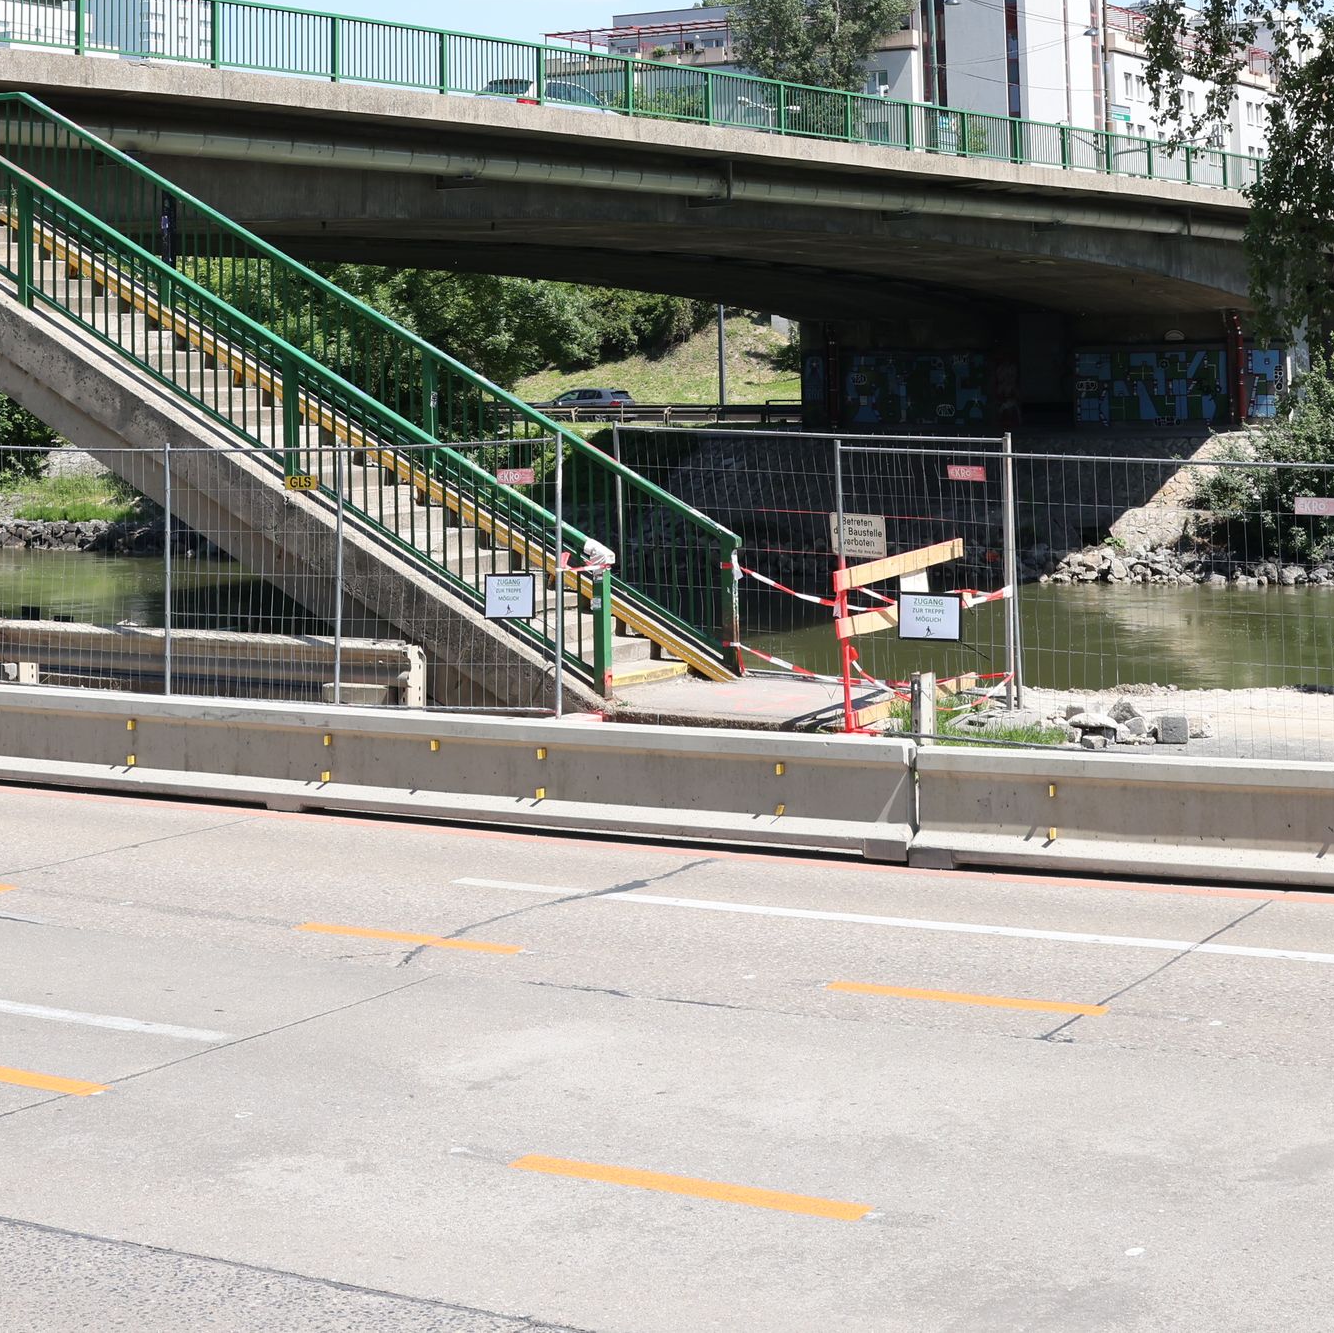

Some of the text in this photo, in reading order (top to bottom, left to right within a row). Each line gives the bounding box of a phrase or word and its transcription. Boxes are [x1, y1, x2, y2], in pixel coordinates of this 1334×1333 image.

[289, 476, 312, 488] GLS
[848, 526, 883, 538] Baustelle
[497, 578, 521, 586] ZUGANG
[913, 597, 944, 606] ZUGANG
